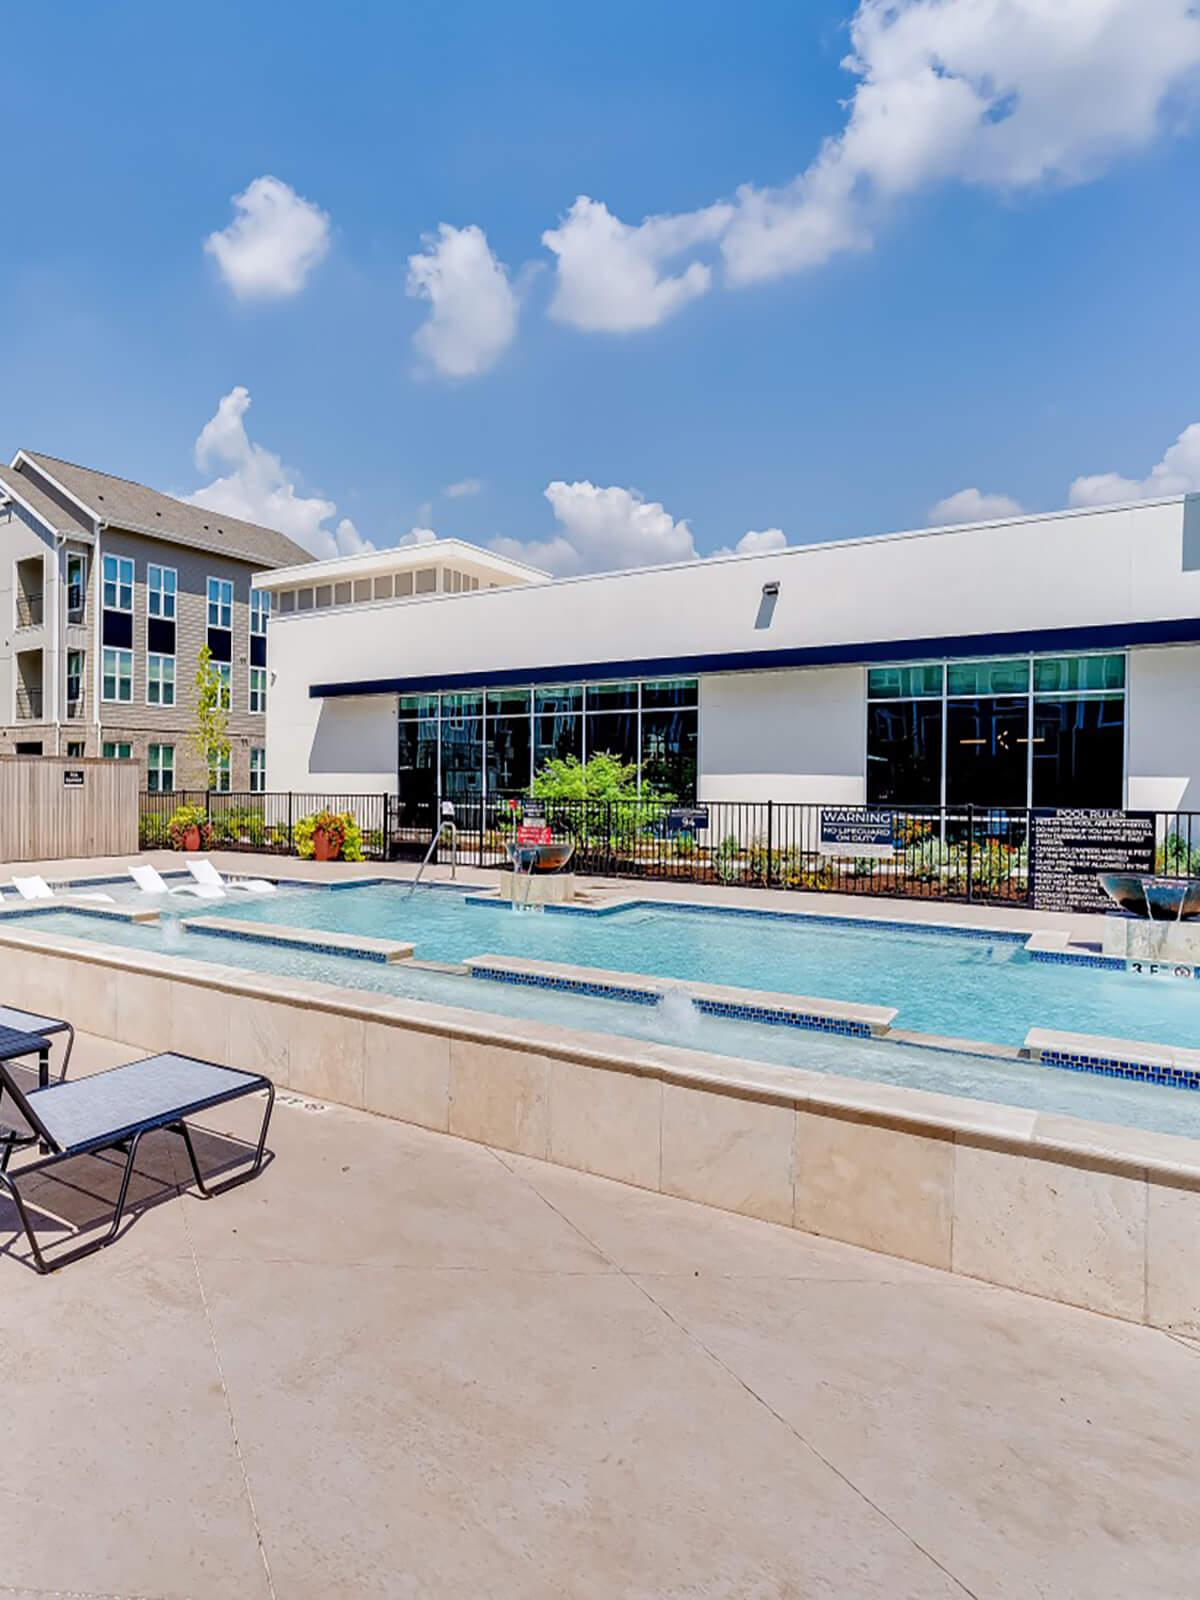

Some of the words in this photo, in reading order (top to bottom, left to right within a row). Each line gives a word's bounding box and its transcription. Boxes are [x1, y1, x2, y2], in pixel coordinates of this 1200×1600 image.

[823, 811, 891, 823] WARNING
[1056, 809, 1087, 819] POOL
[1090, 809, 1126, 819] RULES
[823, 827, 838, 835] NO
[839, 827, 891, 837] LIFEGUARD
[836, 834, 850, 842] ON
[851, 834, 876, 843] DUTY
